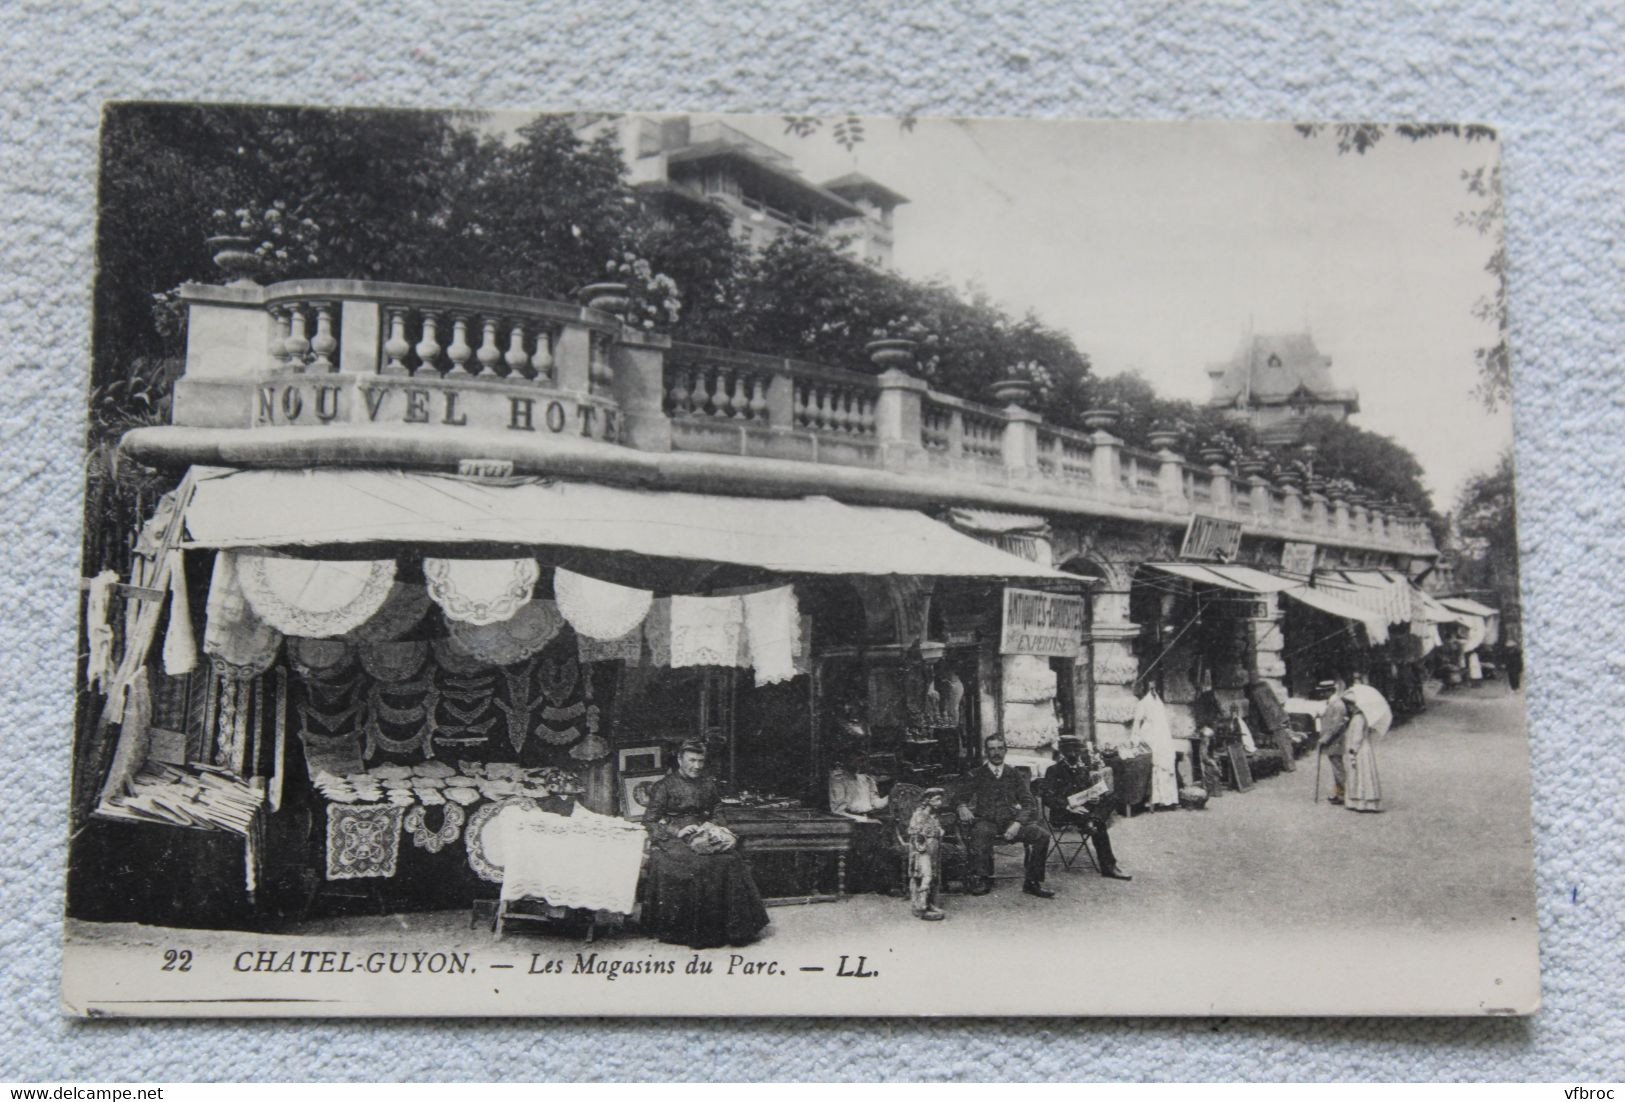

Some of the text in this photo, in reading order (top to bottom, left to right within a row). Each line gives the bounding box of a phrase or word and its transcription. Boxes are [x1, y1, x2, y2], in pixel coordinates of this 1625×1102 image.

[256, 384, 467, 427] NOUVEL
[161, 949, 193, 972] 22
[233, 950, 477, 974] CHATEL-GUYON.
[528, 953, 563, 975] Les
[572, 953, 675, 981] Magasins
[685, 953, 713, 975] du
[727, 954, 786, 976] Parc.
[836, 955, 879, 978] LL.
